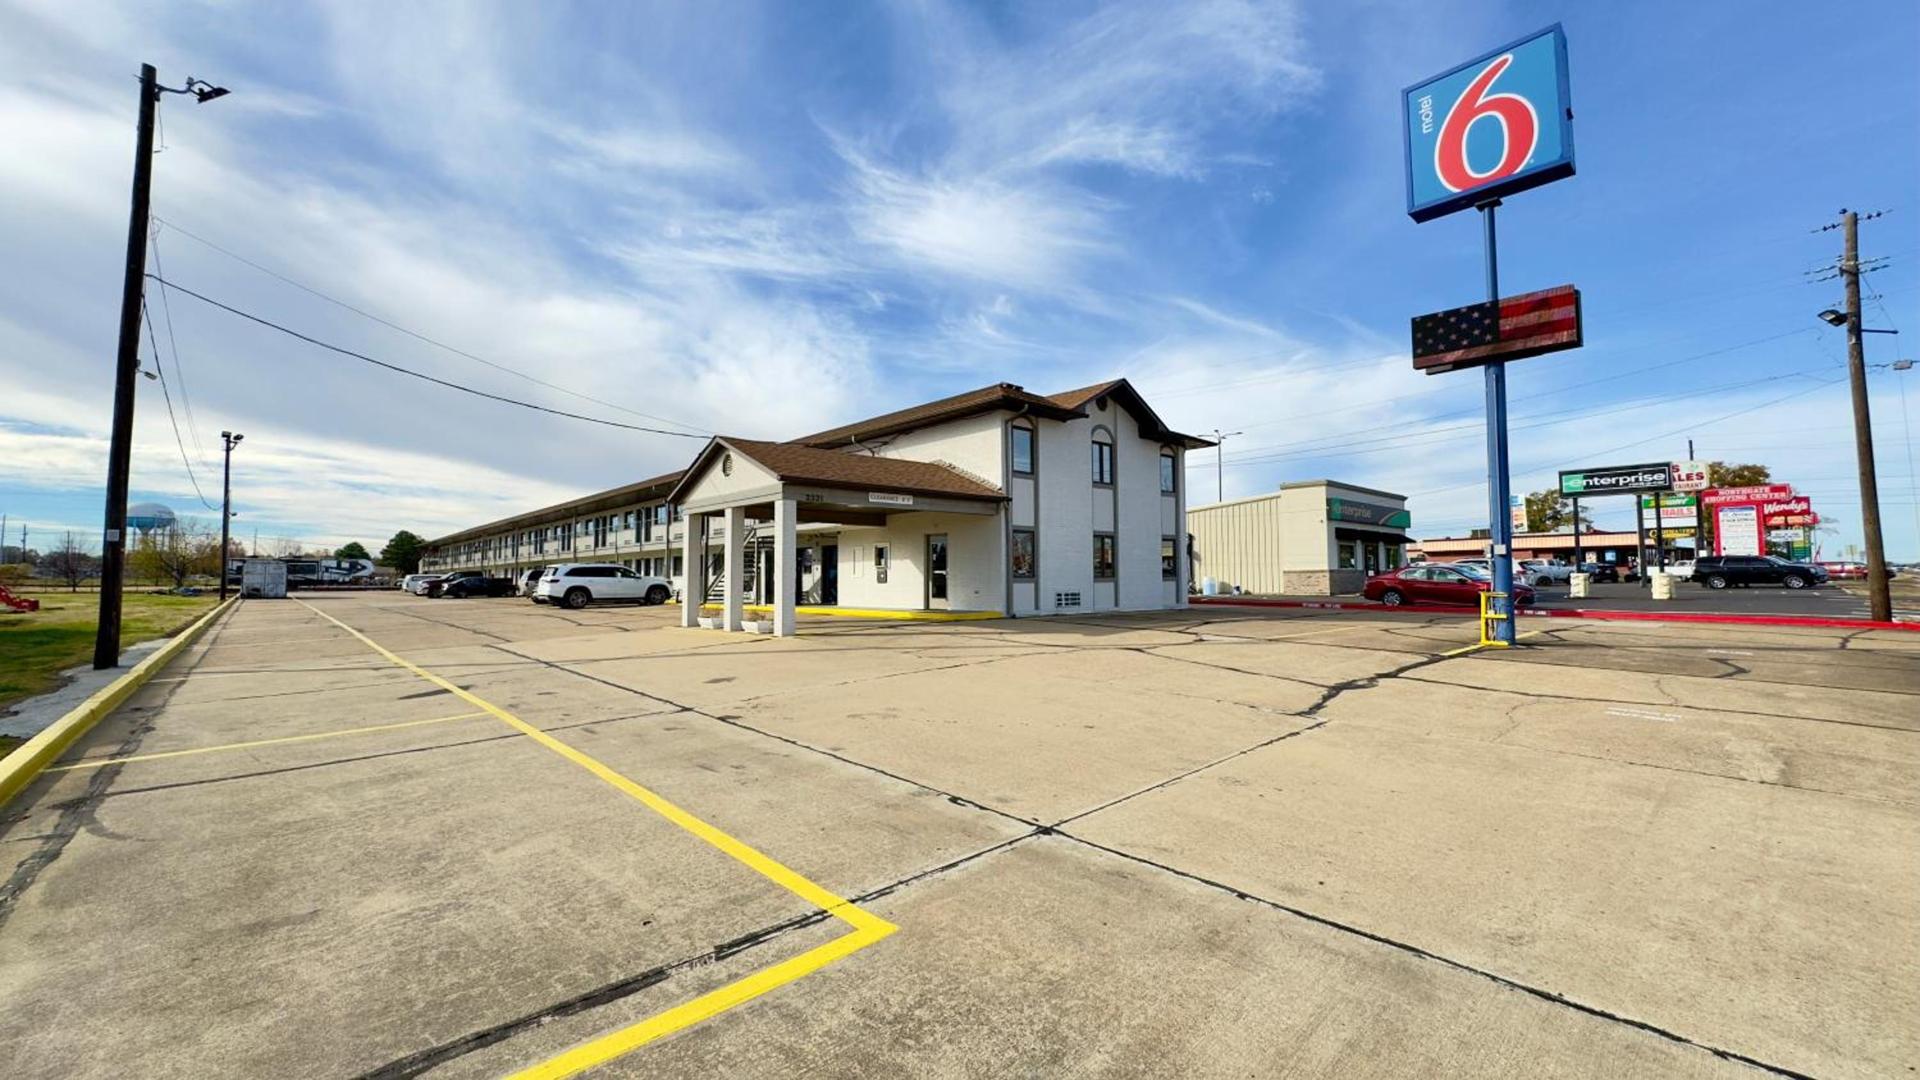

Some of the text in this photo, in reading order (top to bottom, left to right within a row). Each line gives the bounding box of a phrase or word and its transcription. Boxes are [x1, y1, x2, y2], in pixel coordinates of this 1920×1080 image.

[1418, 94, 1434, 134] motel
[1434, 53, 1539, 193] 6
[1566, 472, 1666, 487] enterprise
[1763, 500, 1809, 514] Wendy's
